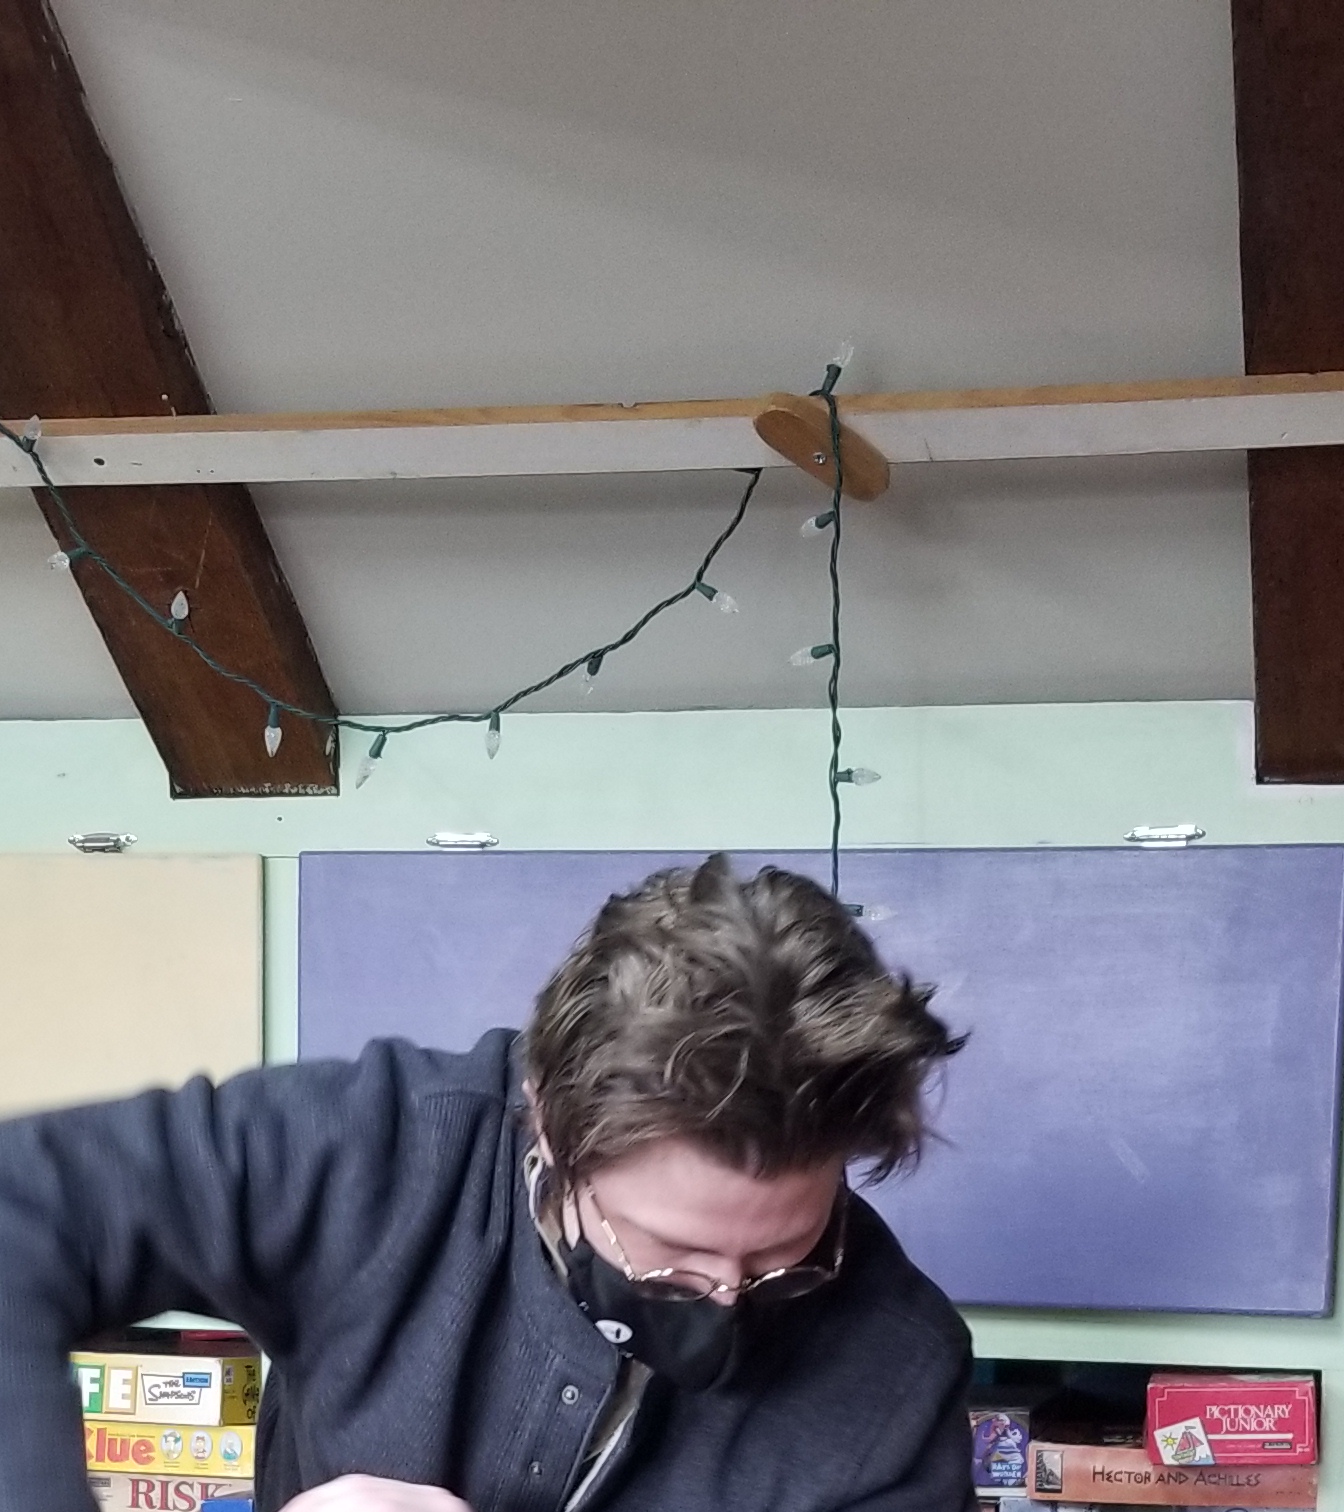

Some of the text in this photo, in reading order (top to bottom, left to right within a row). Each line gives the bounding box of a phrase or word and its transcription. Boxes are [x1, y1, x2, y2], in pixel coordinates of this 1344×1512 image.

[1206, 1404, 1293, 1419] PICTIONARY
[1221, 1416, 1277, 1434] JUNIOR
[1092, 1465, 1262, 1487] HECTOR AND ACHILLES
